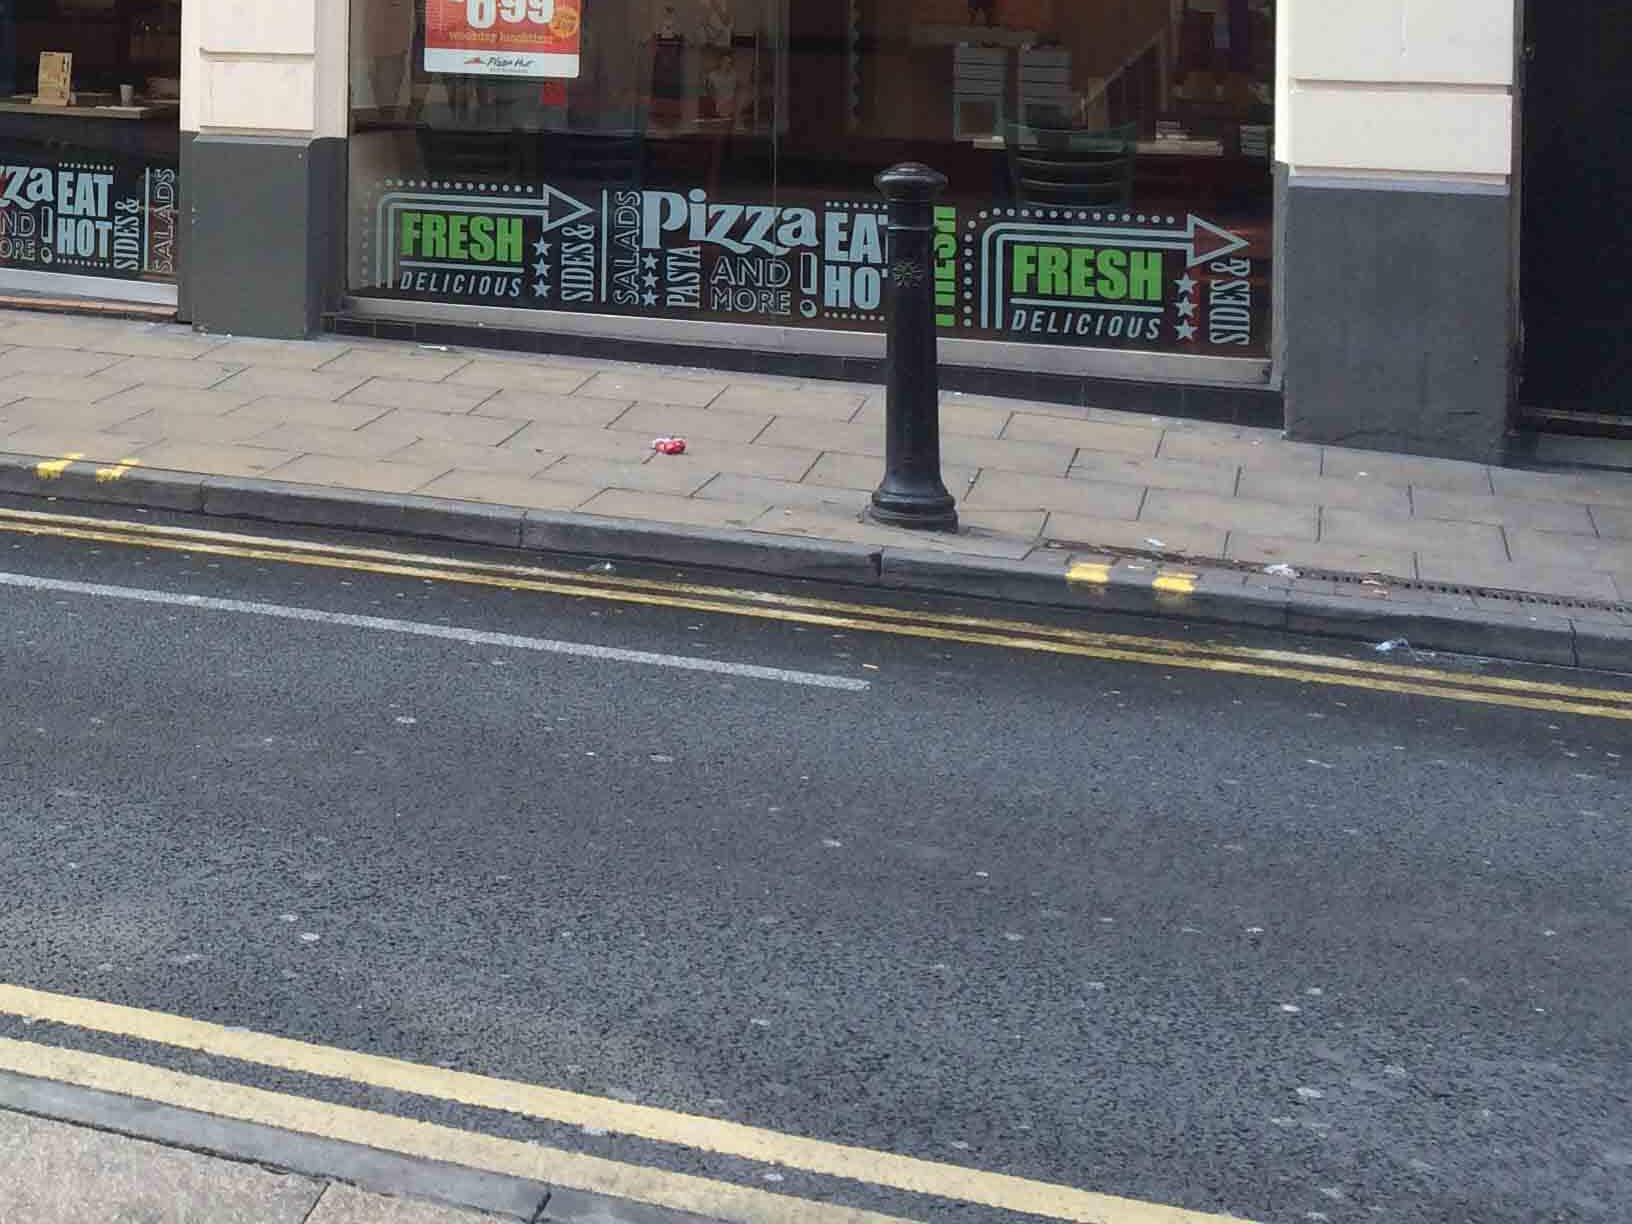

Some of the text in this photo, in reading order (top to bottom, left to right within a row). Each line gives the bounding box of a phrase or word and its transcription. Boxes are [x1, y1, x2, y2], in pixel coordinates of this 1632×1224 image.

[58, 171, 114, 218] EAT
[152, 168, 176, 274] SALADS
[57, 217, 113, 258] HOT
[114, 197, 141, 271] SIDES &
[400, 212, 524, 264] FRESH
[613, 191, 641, 305] SALADS
[641, 188, 819, 256] Pizza
[399, 270, 522, 297] DELICIOUS
[561, 224, 595, 302] SIDES &
[667, 245, 702, 310] PASTA
[710, 255, 792, 288] AND
[824, 264, 888, 310] HO
[1012, 245, 1163, 301] FRESH
[711, 287, 792, 316] MORE
[1011, 309, 1161, 340] DELICIOUS
[1209, 258, 1250, 345] SIDES &
